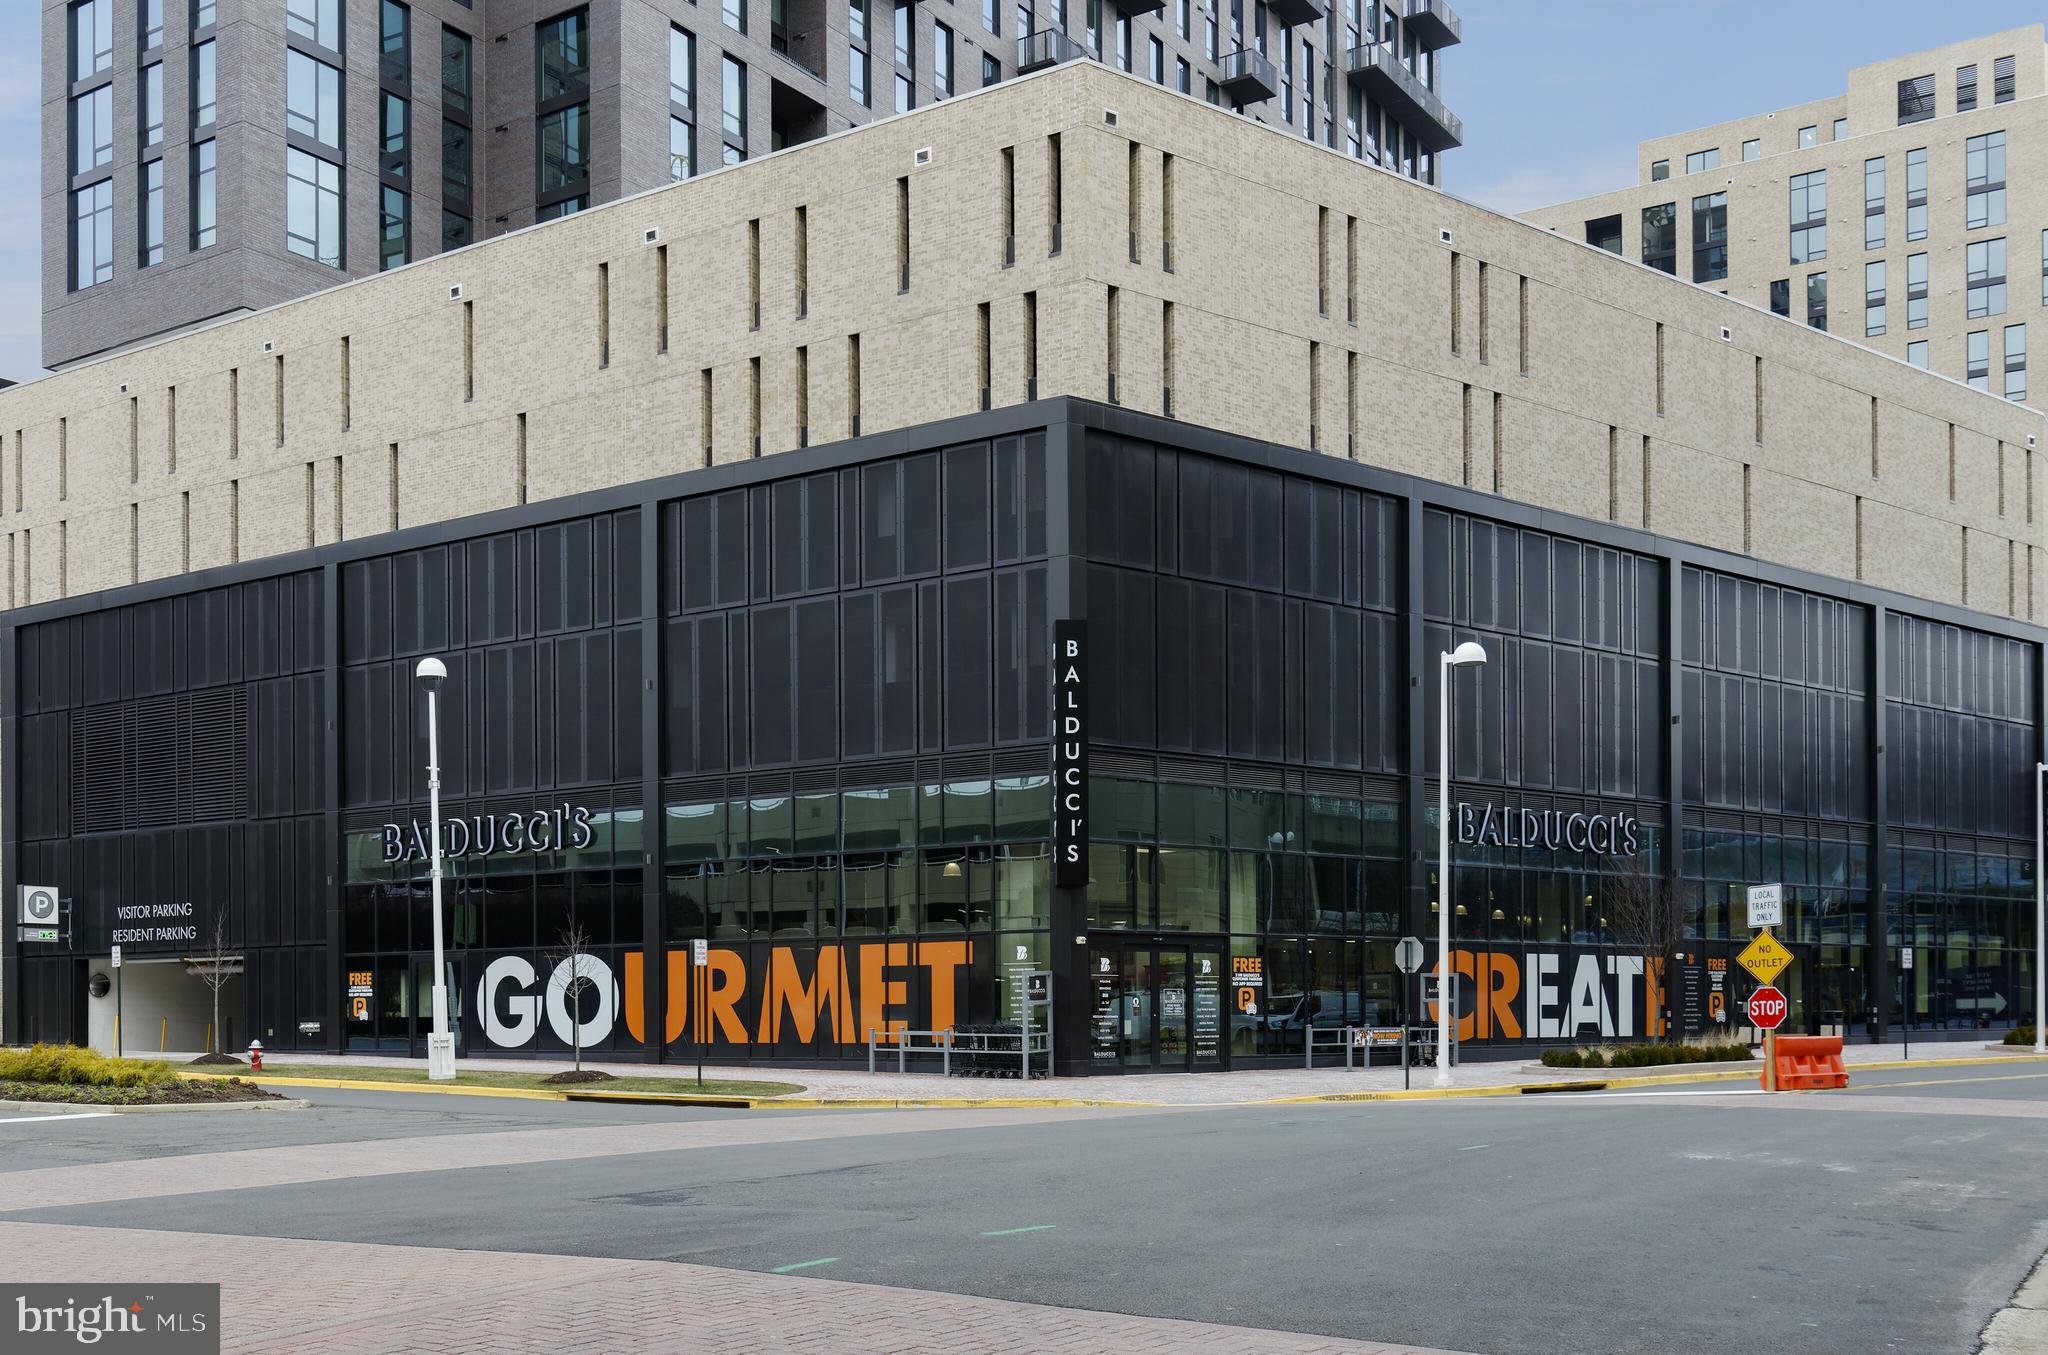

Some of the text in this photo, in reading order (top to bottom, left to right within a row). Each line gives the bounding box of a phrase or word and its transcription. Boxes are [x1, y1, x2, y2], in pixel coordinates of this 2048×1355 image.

[1063, 639, 1083, 862] BALDUCCI'S
[1456, 801, 1641, 857] BALDUCCI'S
[1754, 890, 1775, 900] LOCAL
[35, 895, 49, 913] P
[117, 902, 193, 920] VISITOR PARKING
[1752, 900, 1777, 911] TRAFFIC
[1756, 912, 1773, 922] ONLY
[112, 925, 197, 943] RESIDENT PARKING
[1758, 944, 1772, 954] NO
[1233, 957, 1262, 973] FREE
[1707, 958, 1727, 971] FREE
[1747, 957, 1784, 969] OUTLET
[349, 972, 372, 986] FREE
[477, 941, 974, 1048] GOURMET
[1427, 949, 1666, 1042] CREATE
[1750, 1000, 1784, 1016] STOP
